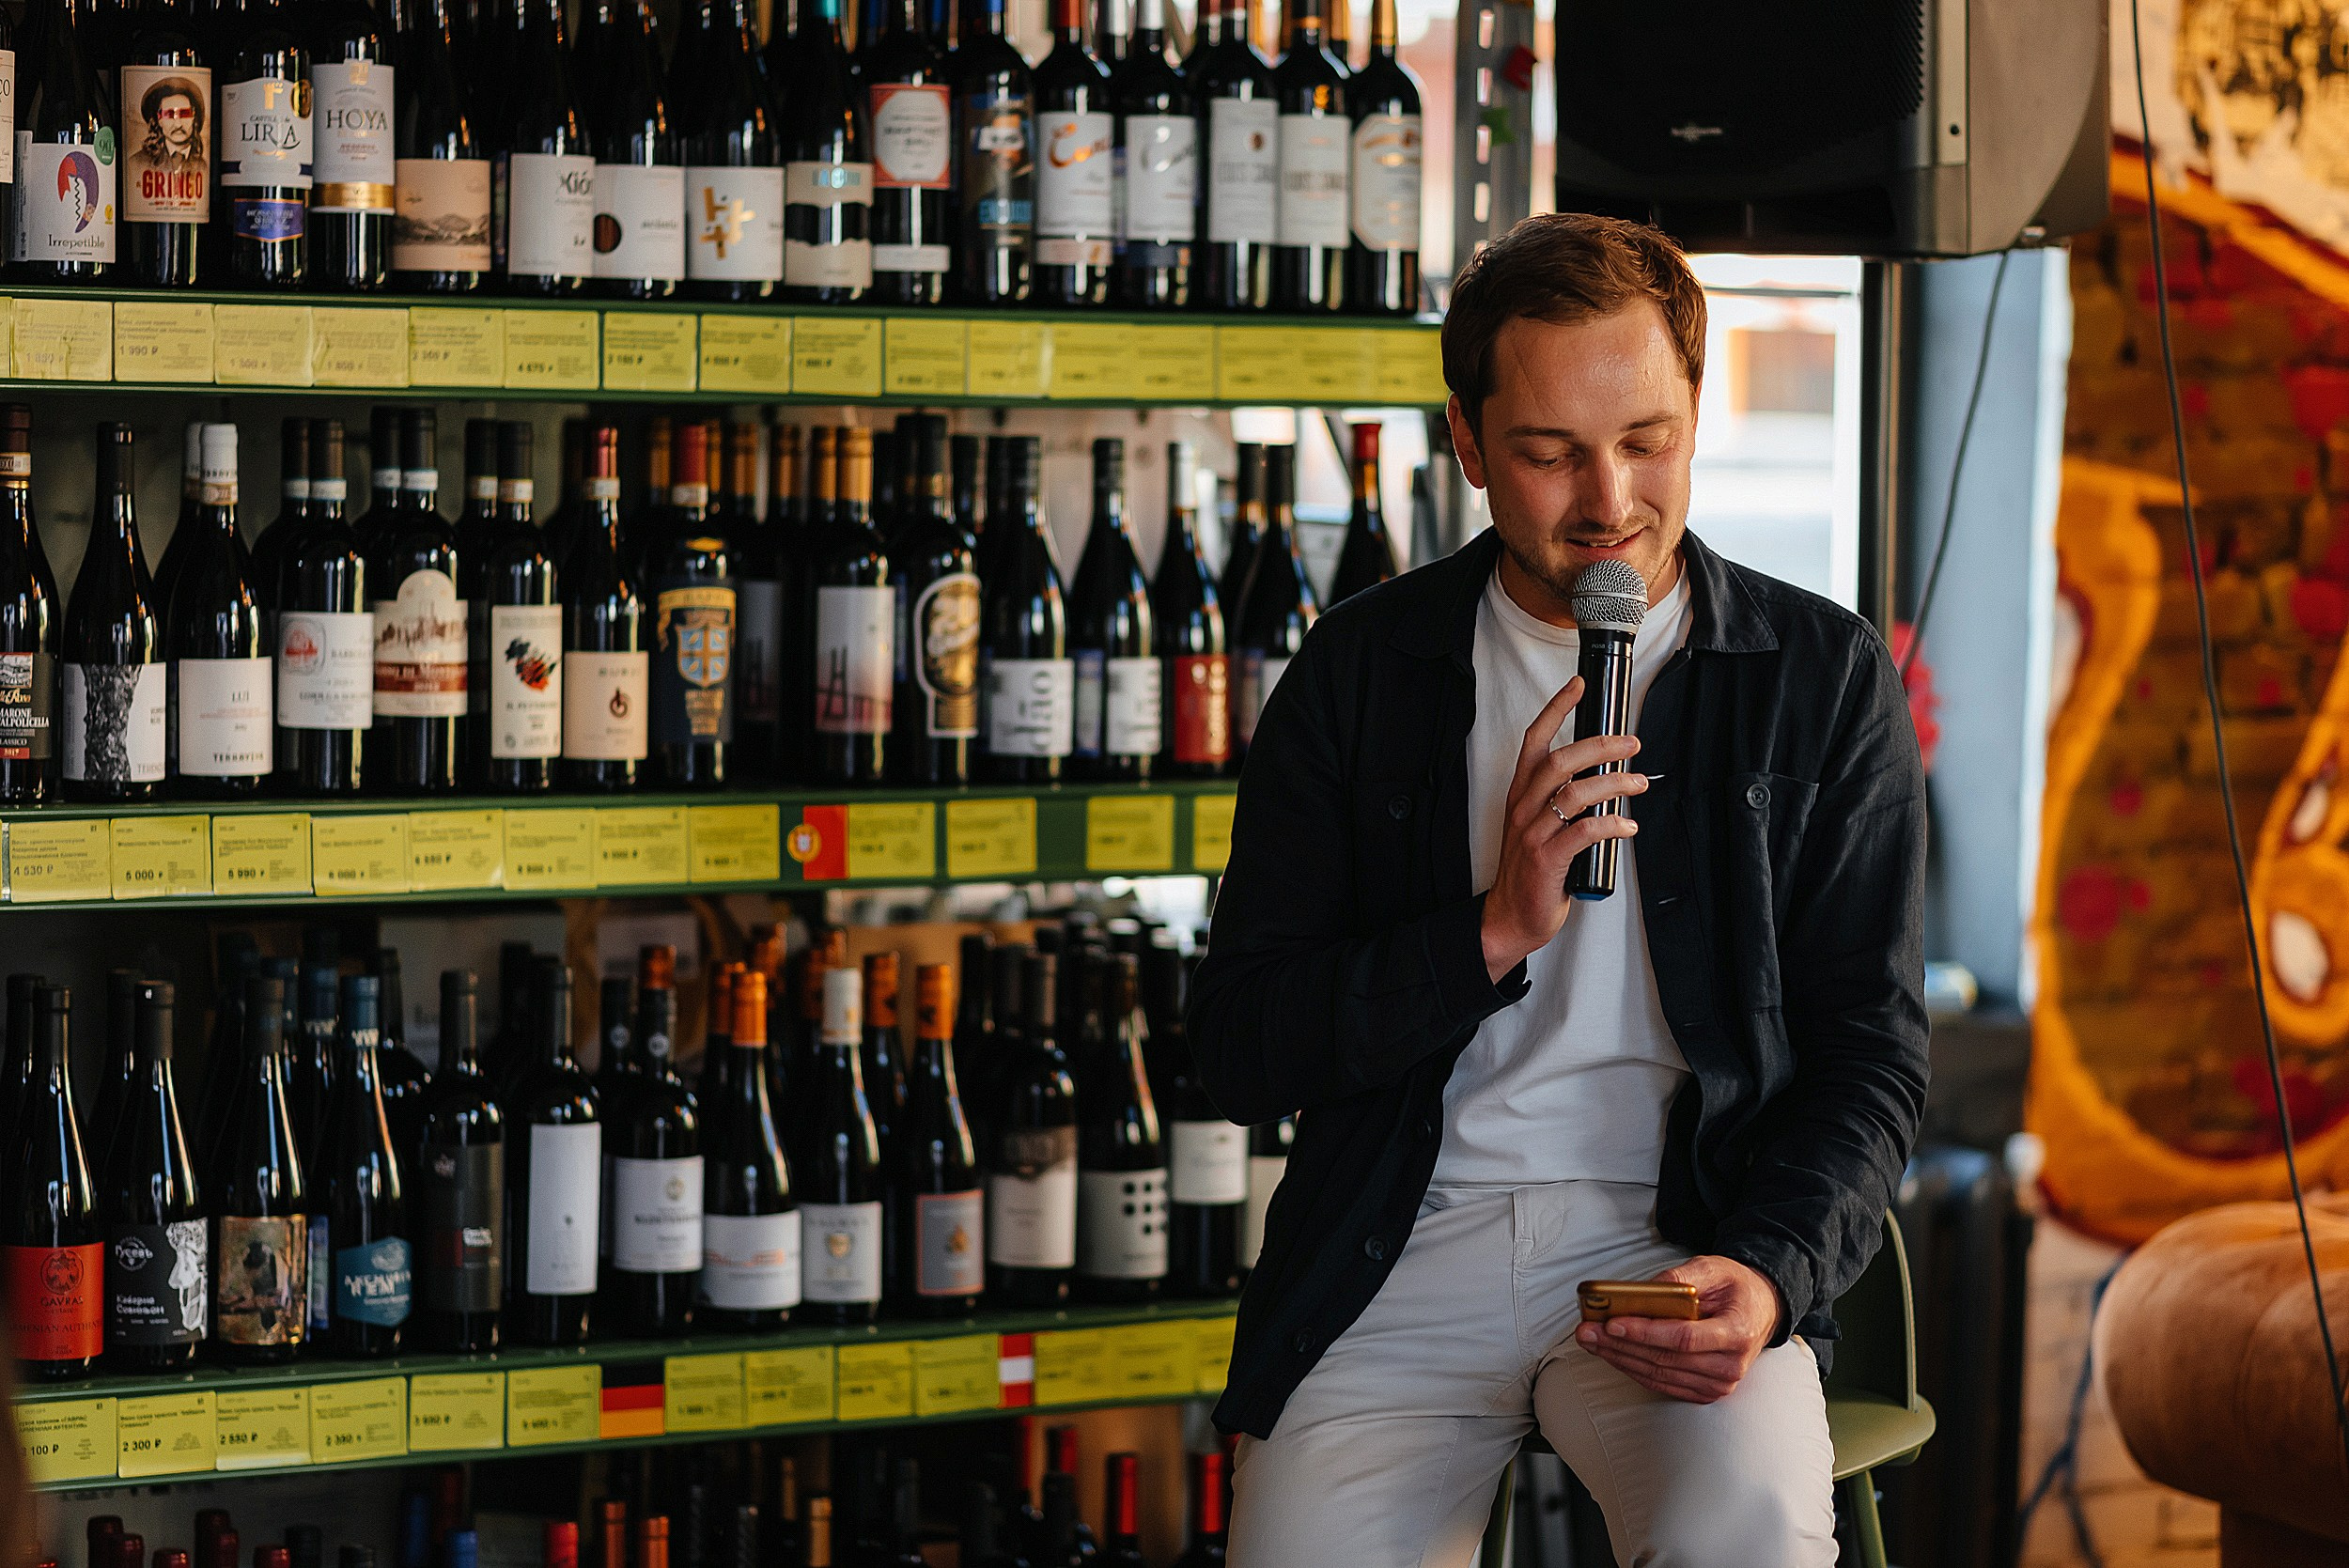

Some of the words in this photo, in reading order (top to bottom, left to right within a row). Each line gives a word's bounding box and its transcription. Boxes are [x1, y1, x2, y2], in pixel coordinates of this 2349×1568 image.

[326, 108, 388, 131] HOYA
[241, 123, 300, 148] LIRA
[142, 170, 202, 198] GRINGO
[49, 234, 104, 249] Irrepetible
[134, 869, 154, 880] 000
[40, 1296, 83, 1307] GAVRAS
[32, 1444, 48, 1455] 100
[132, 1438, 150, 1452] 300
